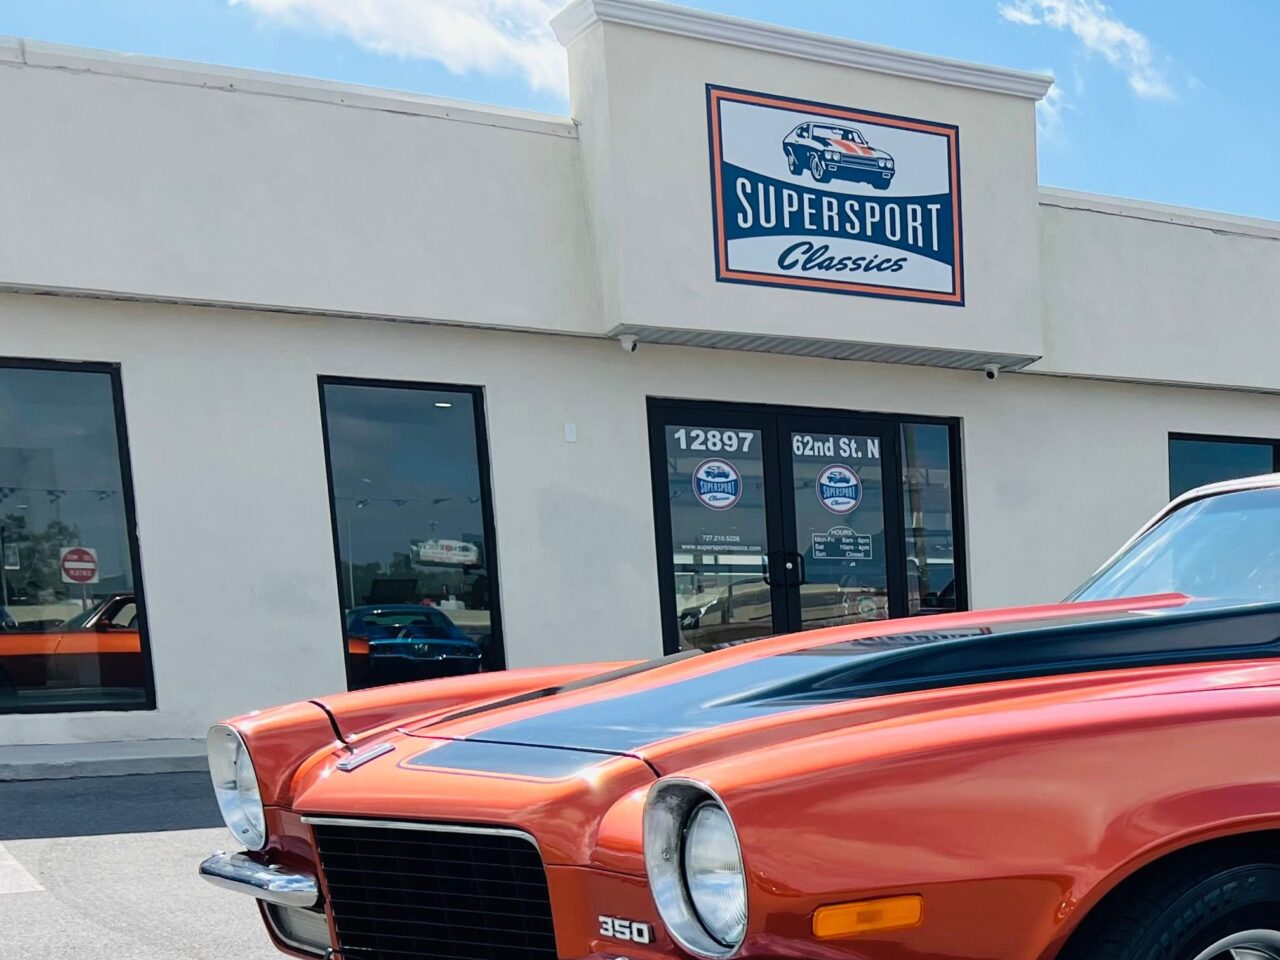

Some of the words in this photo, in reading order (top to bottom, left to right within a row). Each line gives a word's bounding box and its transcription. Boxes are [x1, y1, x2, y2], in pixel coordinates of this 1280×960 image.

[735, 176, 942, 252] SUPERSPORT
[777, 241, 908, 274] Classics
[674, 429, 754, 452] 12897
[792, 435, 834, 457] 62nd
[839, 437, 862, 458] St.
[866, 439, 880, 459] N
[700, 480, 735, 495] SUPERSPORT
[823, 485, 855, 499] SUPERSPORT
[598, 915, 650, 945] 350
